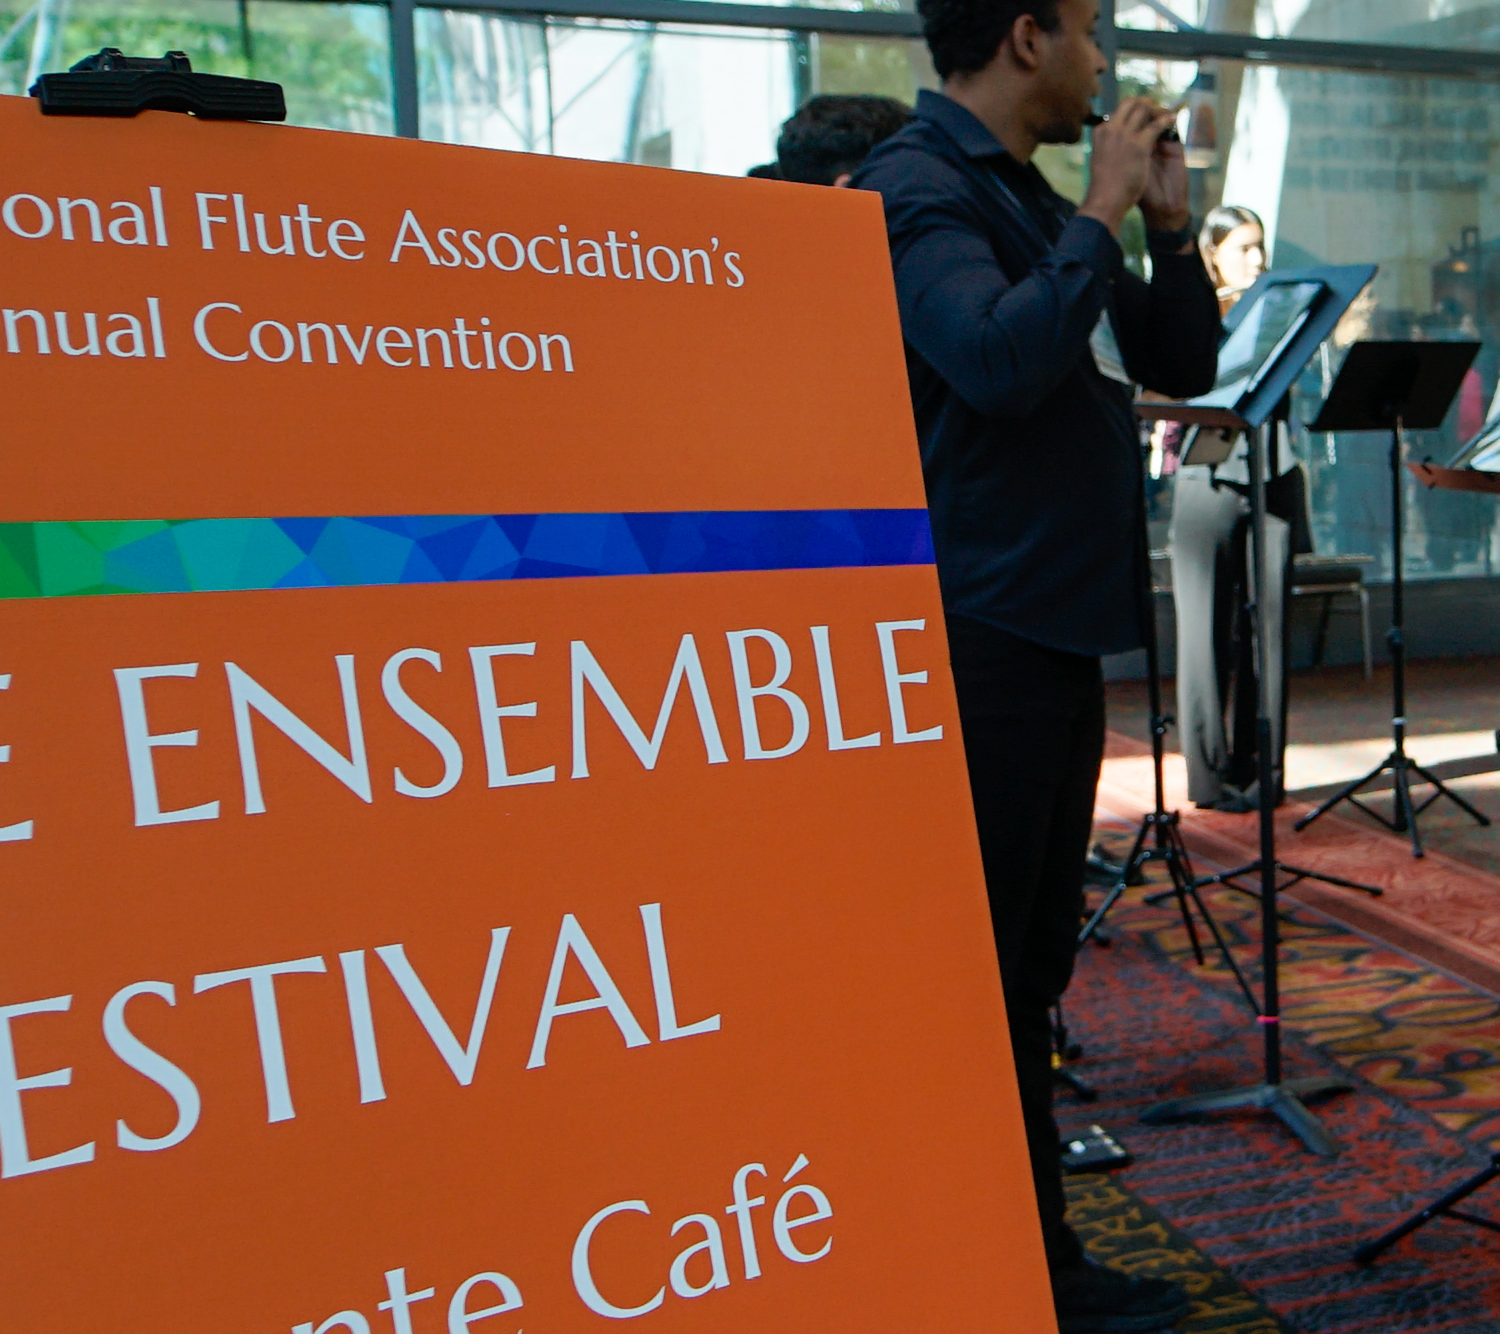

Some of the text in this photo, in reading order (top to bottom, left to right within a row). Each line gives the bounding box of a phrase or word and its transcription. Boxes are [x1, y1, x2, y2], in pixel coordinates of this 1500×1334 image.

[196, 193, 365, 260] Flute
[390, 210, 744, 287] Association's
[194, 303, 574, 372] Convention
[113, 619, 943, 826] ENSEMBLE
[572, 1154, 834, 1319] Café
